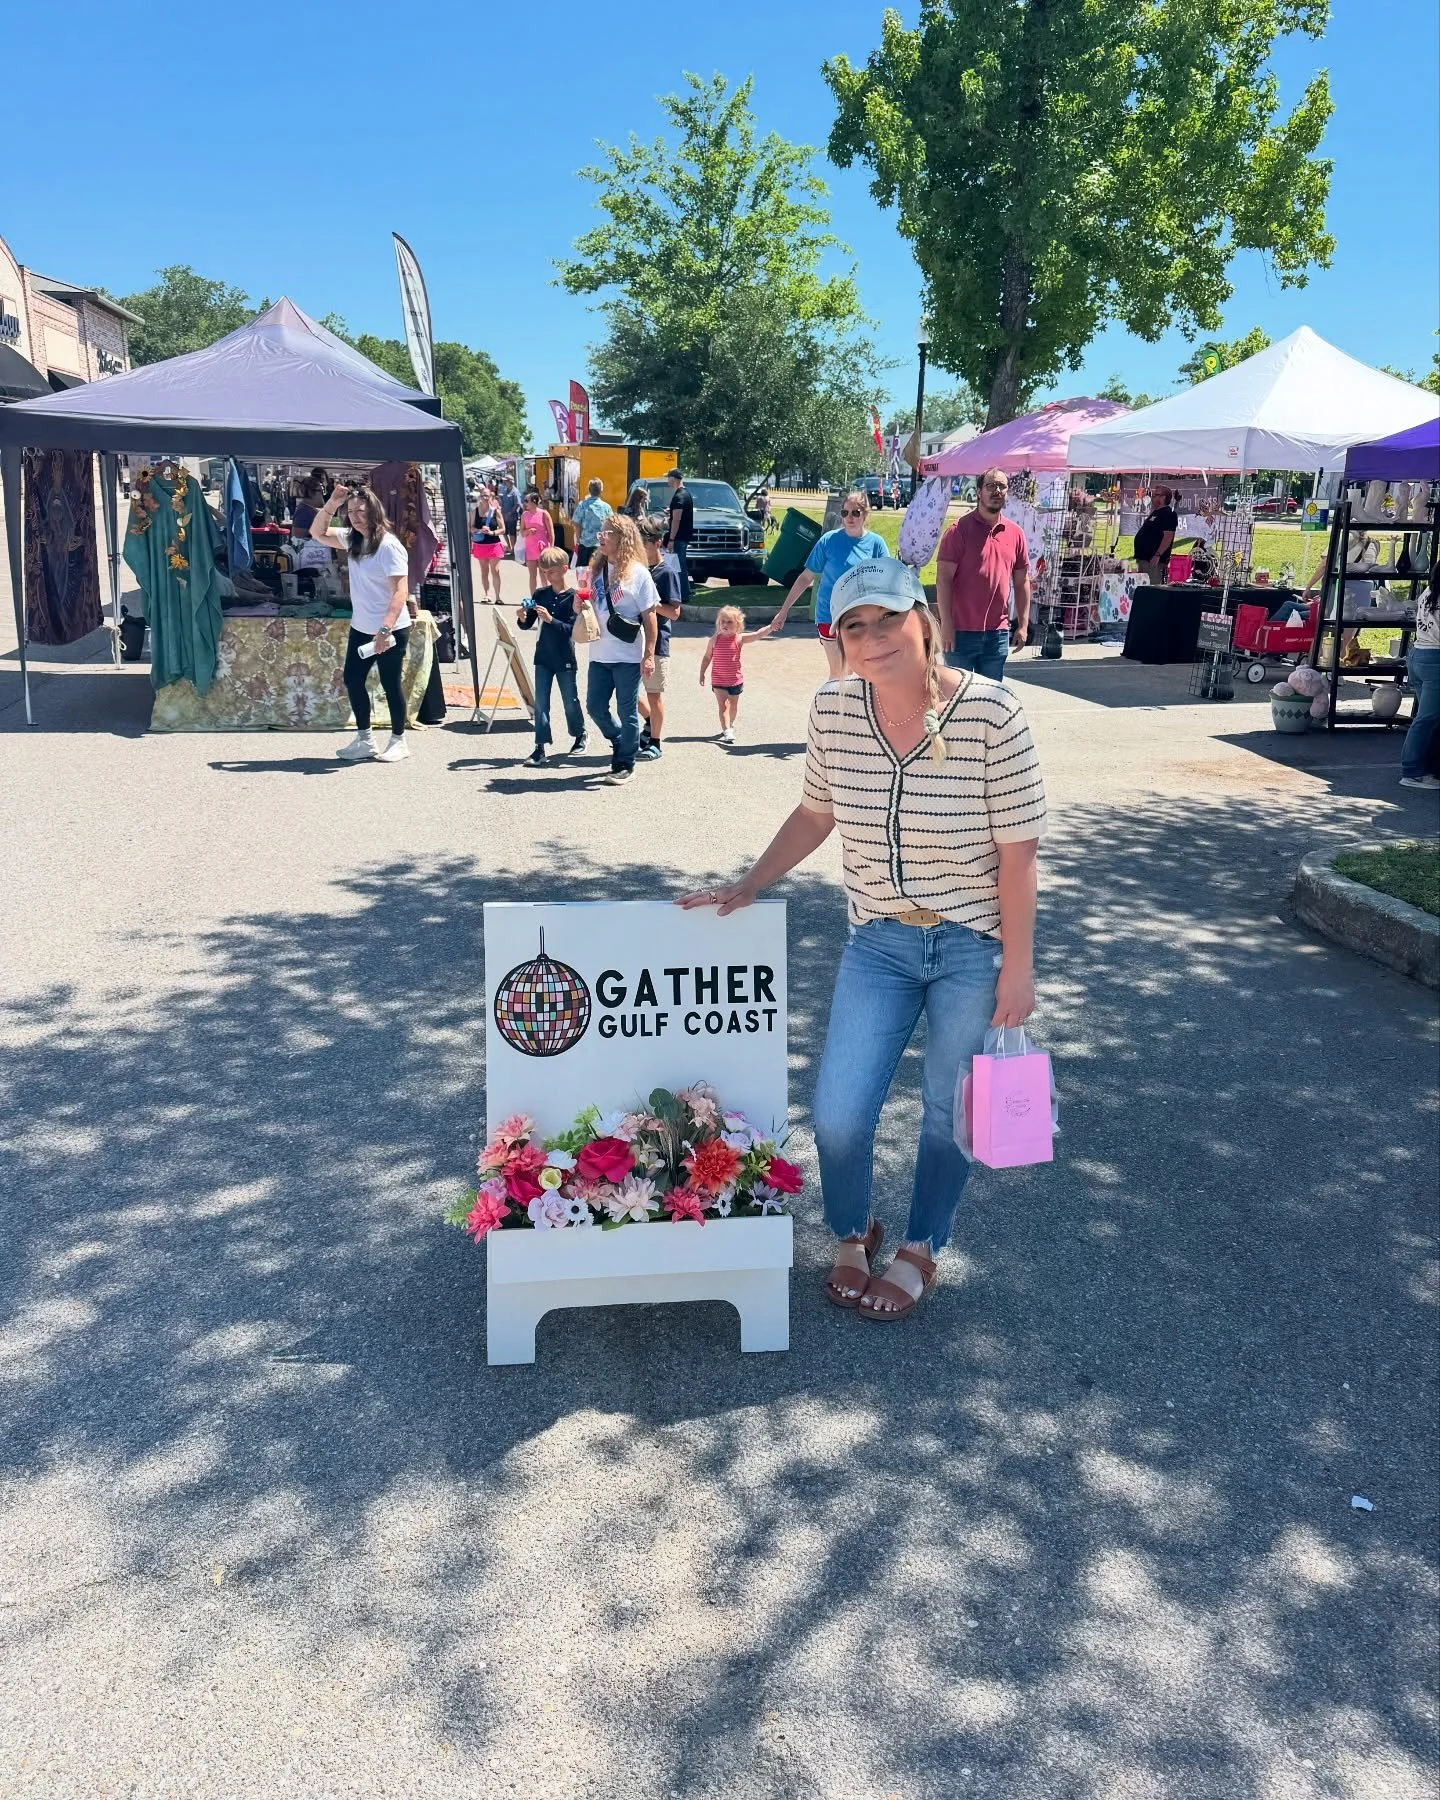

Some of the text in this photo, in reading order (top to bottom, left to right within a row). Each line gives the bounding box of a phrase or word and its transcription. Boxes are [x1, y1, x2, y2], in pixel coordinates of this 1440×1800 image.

[595, 964, 777, 1009] GATHER
[598, 1008, 778, 1039] GULF COAST
